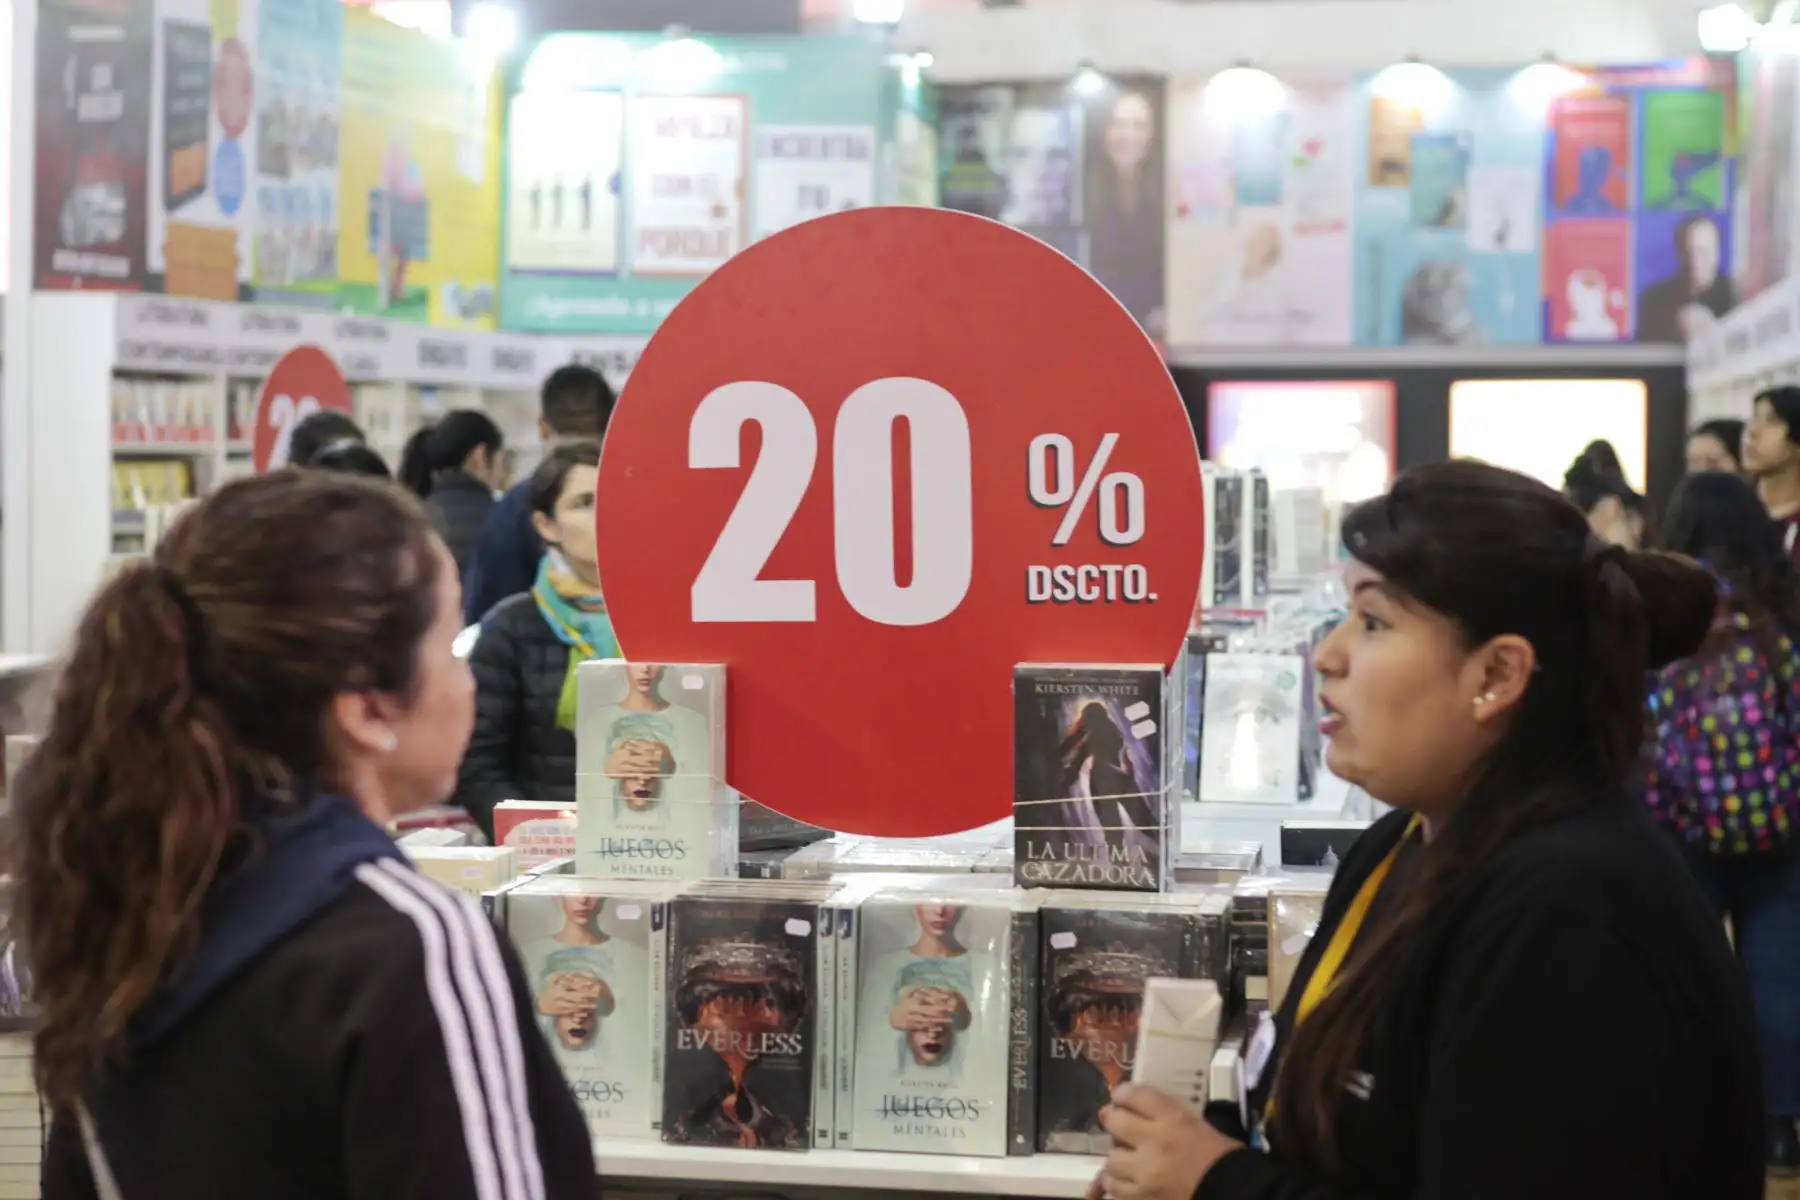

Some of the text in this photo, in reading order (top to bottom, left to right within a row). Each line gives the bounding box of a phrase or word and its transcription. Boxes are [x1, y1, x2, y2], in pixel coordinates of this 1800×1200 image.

[688, 376, 1145, 625] 20 %
[1027, 563, 1158, 603] DSCTO.
[1098, 685, 1141, 697] WHITE
[600, 836, 685, 860] JUEGOS
[1027, 841, 1056, 860] LA
[611, 864, 674, 876] MENTALES
[1022, 861, 1157, 889] CAZADORA
[677, 1028, 803, 1060] EVERLESS
[1012, 1009, 1032, 1089] EVERLESS
[1051, 1037, 1137, 1070] EVERL
[883, 1094, 980, 1121] JUEGOS
[893, 1124, 966, 1139] MENTALES
